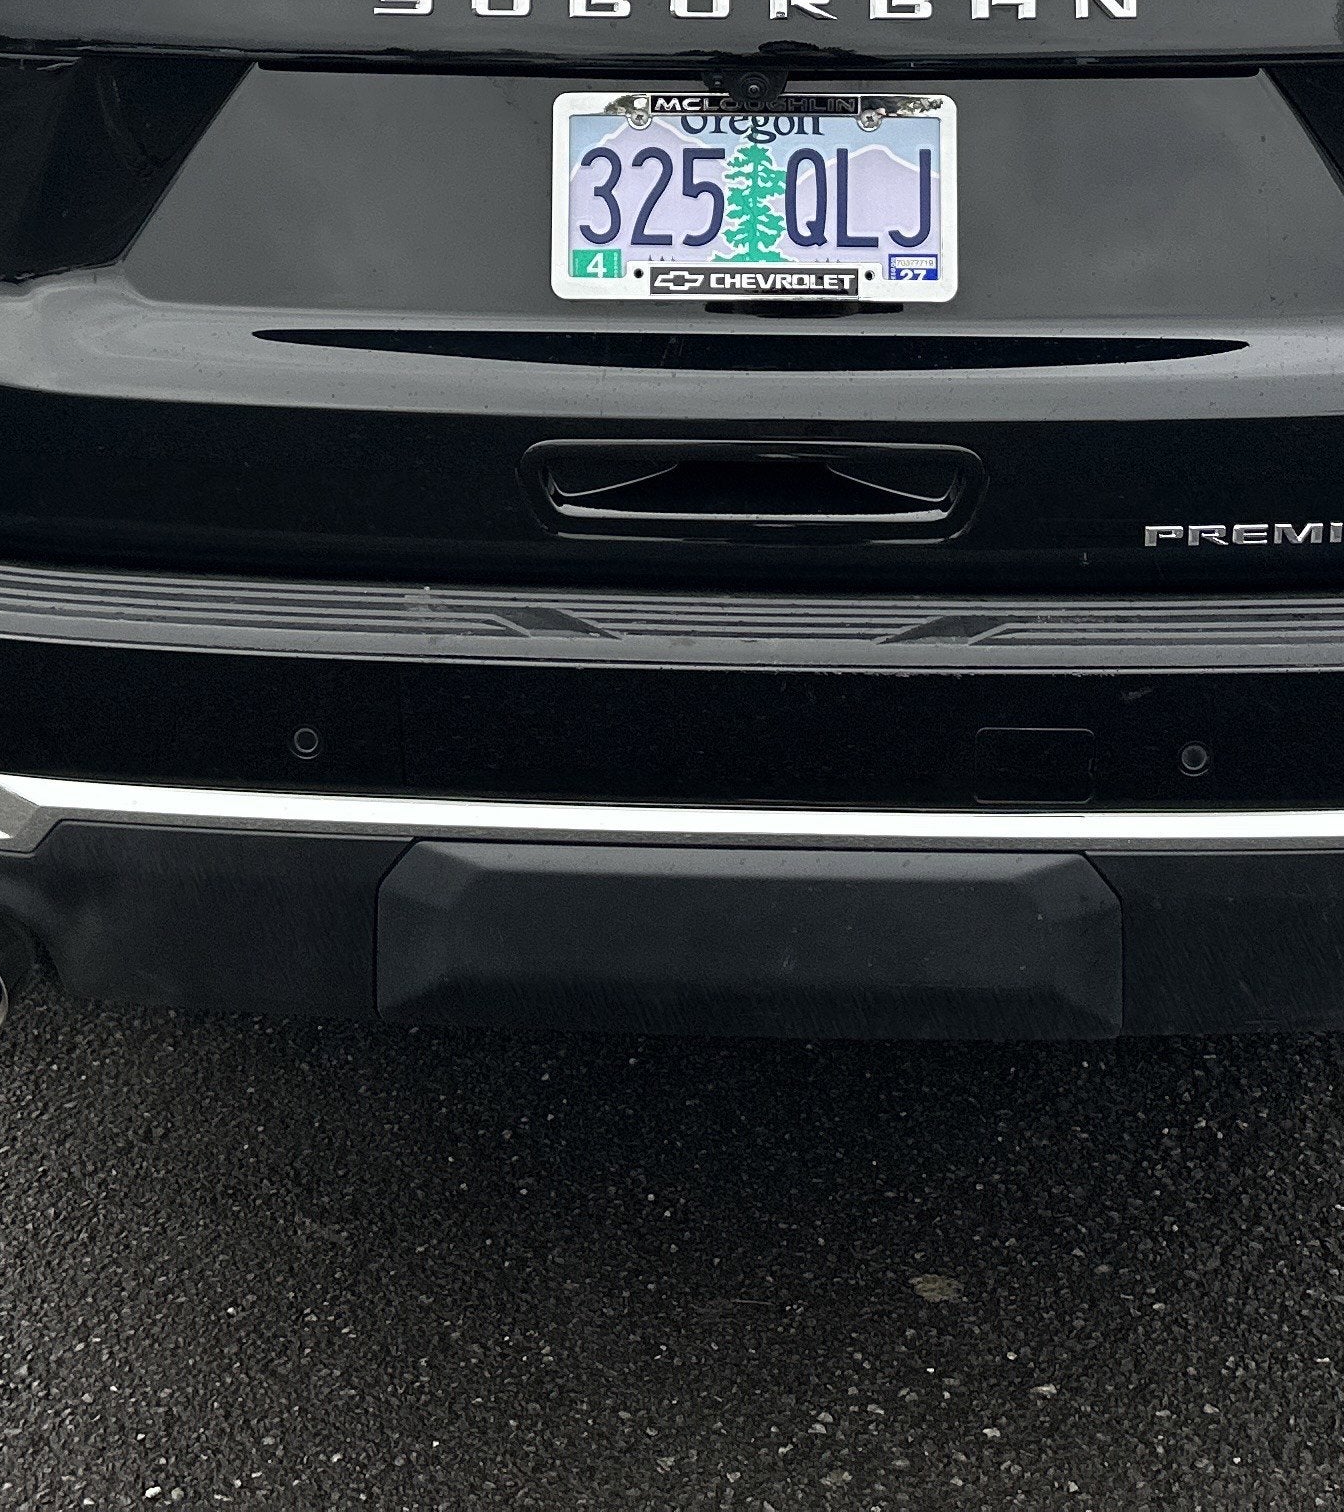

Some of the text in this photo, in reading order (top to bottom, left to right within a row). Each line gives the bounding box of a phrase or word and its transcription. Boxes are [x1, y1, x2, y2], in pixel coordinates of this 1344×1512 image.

[680, 116, 825, 144] Oregon
[579, 146, 932, 248] 325 QLJ
[586, 252, 608, 278] 4
[899, 268, 927, 280] 27
[709, 273, 856, 289] CHEVROLET
